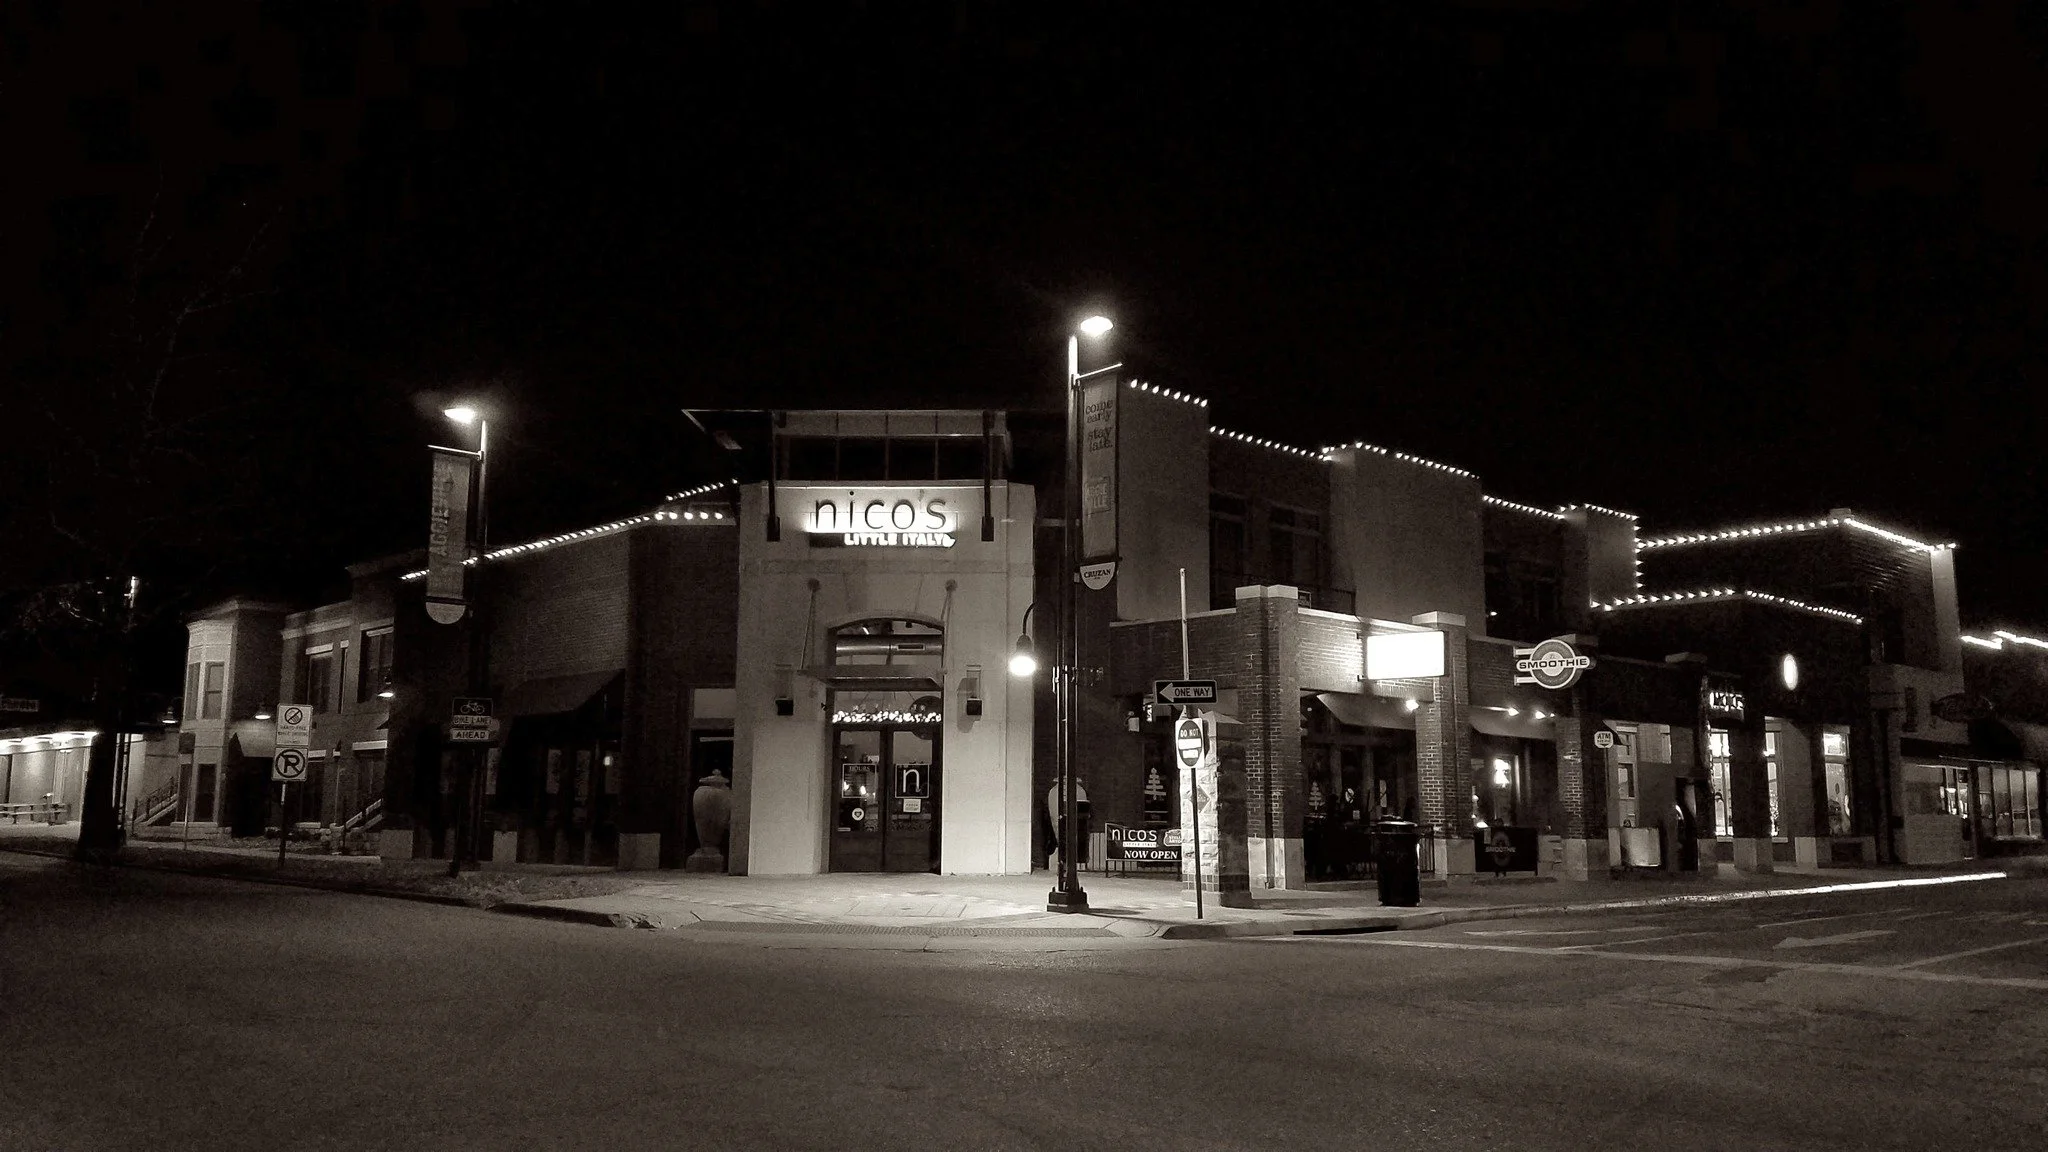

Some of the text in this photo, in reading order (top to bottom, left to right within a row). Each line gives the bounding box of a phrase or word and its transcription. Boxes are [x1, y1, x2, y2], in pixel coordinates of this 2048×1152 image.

[1085, 399, 1112, 414] come
[1086, 410, 1112, 424] early
[1088, 427, 1112, 440] stay
[816, 489, 946, 530] nico's
[844, 533, 945, 546] LITTLE ITALY
[1084, 568, 1111, 578] CRUZAN
[1519, 658, 1587, 670] SMOOTHIE
[1174, 688, 1210, 697] ONE WAY
[456, 731, 485, 739] AHEAD
[1180, 728, 1199, 738] DO NOT
[903, 768, 921, 793] n
[1124, 850, 1178, 859] NOW OPEN
